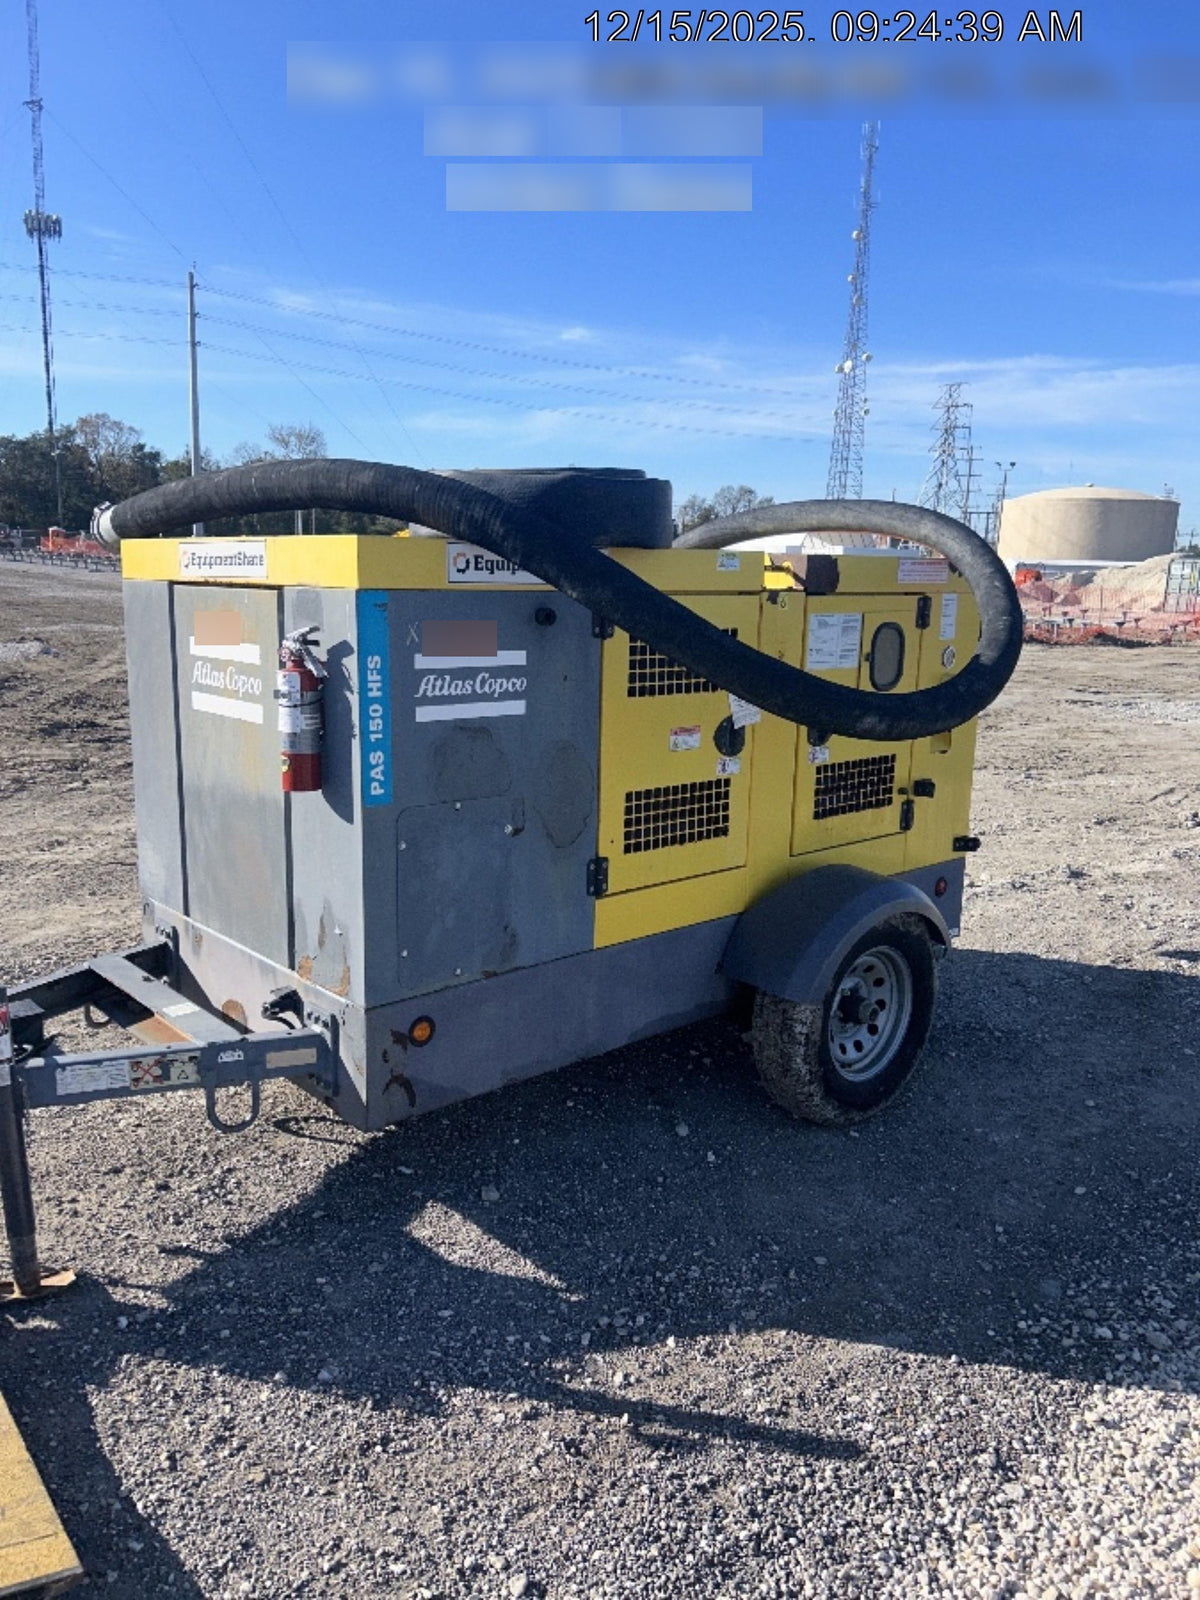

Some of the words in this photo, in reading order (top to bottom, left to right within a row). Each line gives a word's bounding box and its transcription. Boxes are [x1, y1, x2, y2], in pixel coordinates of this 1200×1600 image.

[191, 660, 224, 688] Atlas
[225, 666, 262, 697] Copco
[367, 654, 383, 697] HFS
[413, 674, 474, 698] Atlas
[474, 672, 528, 698] Copco
[368, 703, 383, 742] 150
[369, 751, 385, 796] PAS
